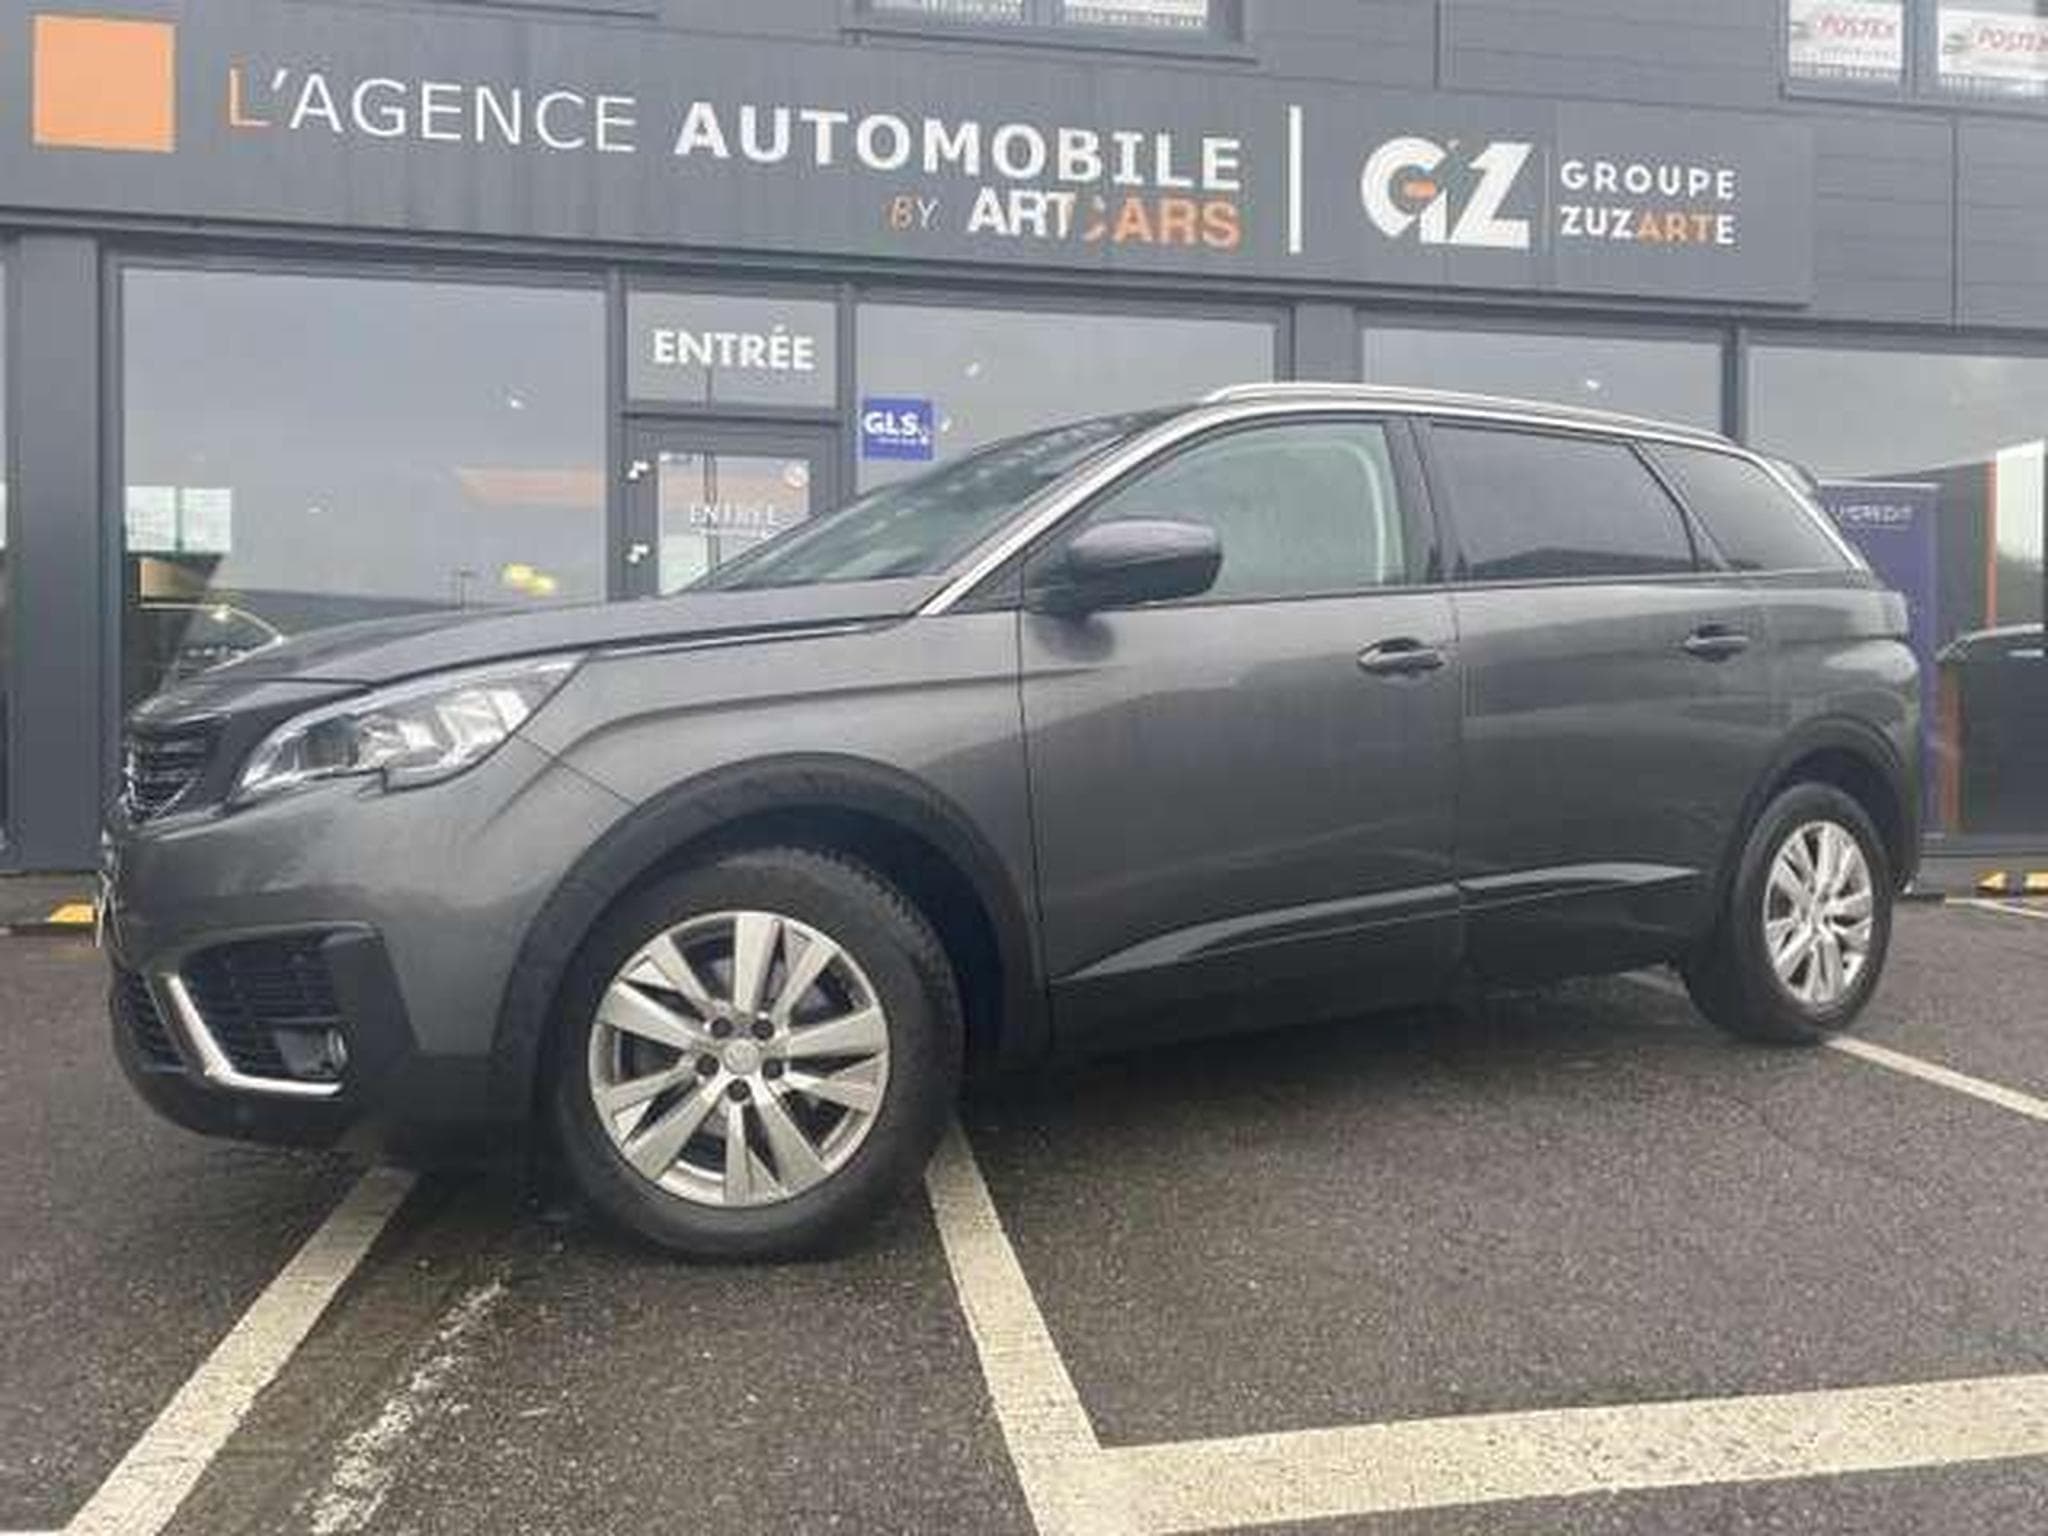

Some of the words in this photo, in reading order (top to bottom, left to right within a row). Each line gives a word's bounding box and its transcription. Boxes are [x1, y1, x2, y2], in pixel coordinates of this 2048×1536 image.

[229, 66, 636, 153] L'AGENCE
[674, 101, 1241, 191] AUTOMOBILE
[1560, 160, 1736, 200] GROUPE
[889, 197, 938, 229] BY
[1560, 205, 1736, 245] ZUZARTE
[653, 325, 815, 371] ENTRÉE
